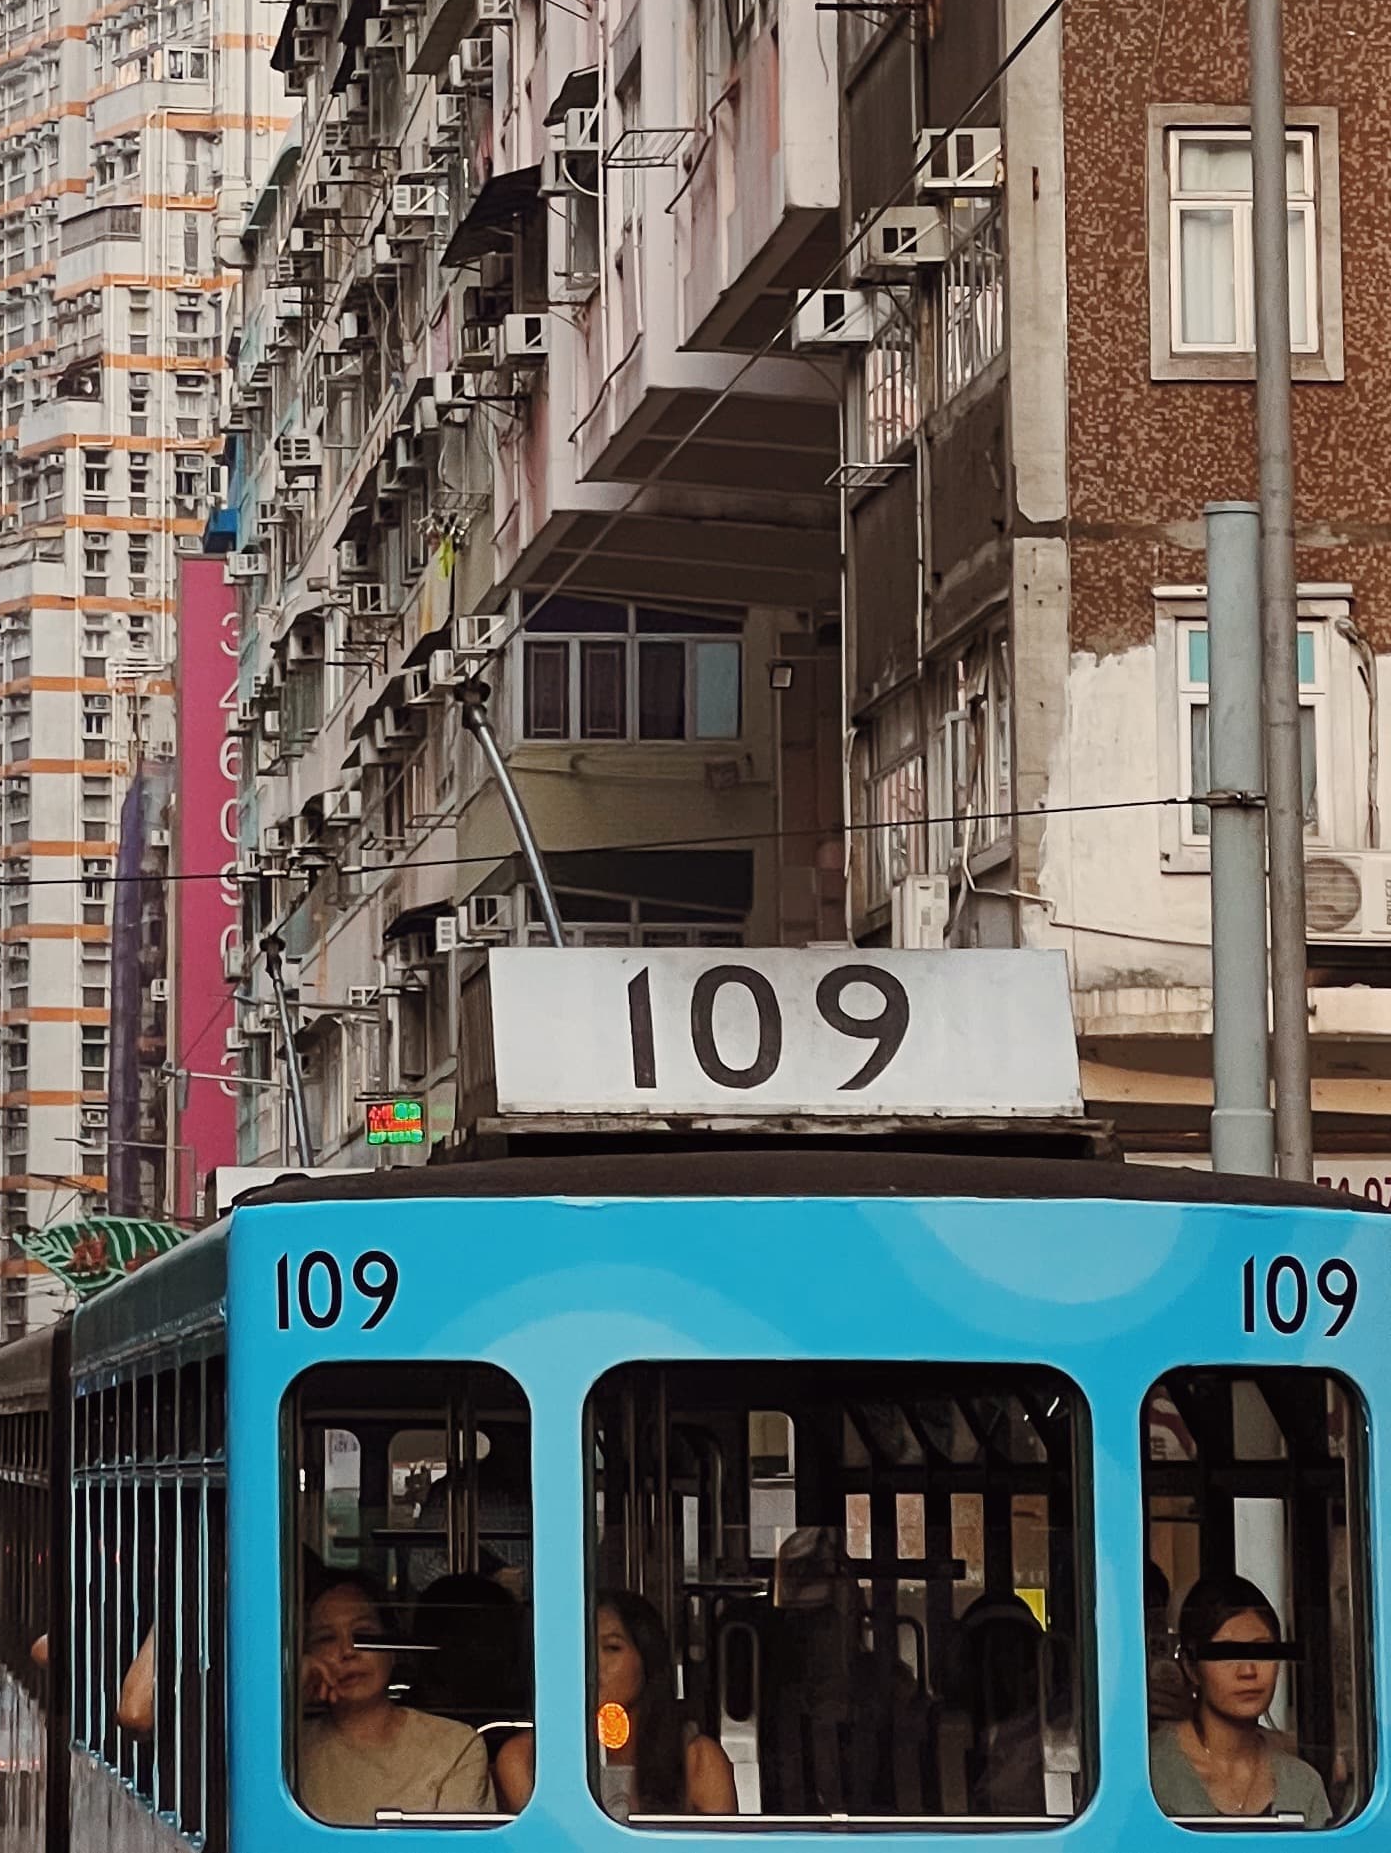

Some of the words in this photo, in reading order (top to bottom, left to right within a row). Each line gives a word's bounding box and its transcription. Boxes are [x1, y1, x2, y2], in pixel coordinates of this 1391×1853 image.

[628, 964, 910, 1090] 109
[277, 1250, 399, 1330] 109
[1243, 1254, 1359, 1337] 109
